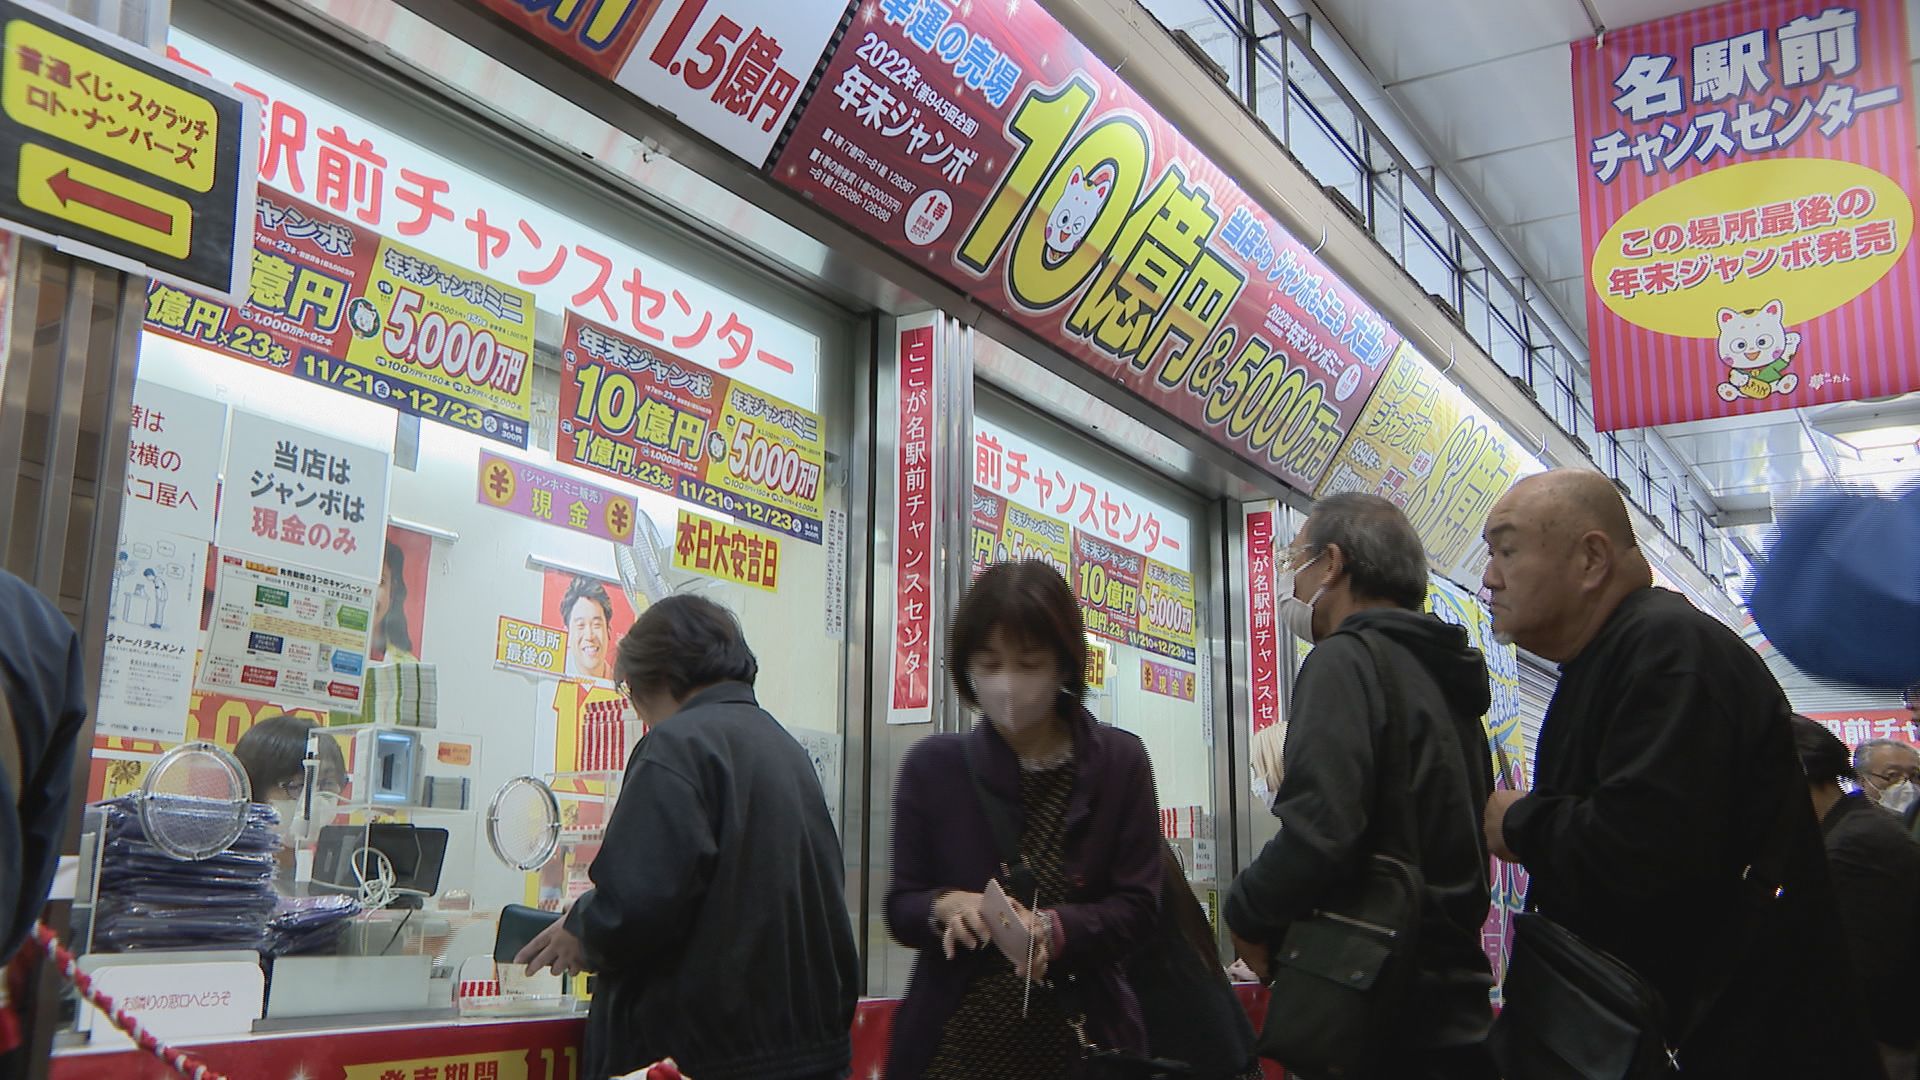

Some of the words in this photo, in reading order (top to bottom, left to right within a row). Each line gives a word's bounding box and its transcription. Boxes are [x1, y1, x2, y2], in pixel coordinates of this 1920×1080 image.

[16, 44, 209, 141] 普通くじ・スクラッチ
[650, 0, 800, 133] 1.5億円
[855, 32, 980, 139] 2022年(第945回全国)
[880, 0, 1022, 107] 幸運の売場
[1613, 8, 1858, 121] 名駅前
[26, 85, 199, 170] ロト・ナンバーズ
[832, 65, 978, 185] 年末ジャンボ
[1591, 85, 1899, 183] チャンスセンター
[954, 73, 1247, 387] 10億円
[1608, 219, 1897, 298] 年末ジャンボ発売
[1620, 185, 1875, 259] この場所最後の
[384, 248, 524, 324] 年末ジャンボミニ
[383, 286, 528, 396] 5,000万円
[579, 327, 713, 399] 年末ジャンボ
[575, 362, 709, 460] 10億円
[731, 388, 818, 442] 年末ジャンボミニ
[1378, 352, 1441, 421] ドリーム
[250, 469, 365, 524] ジャンボは
[274, 440, 351, 486] 当店は
[728, 418, 820, 502] 5,000万円
[975, 431, 1180, 554] 前チャンスセンター
[251, 505, 359, 556] 現金のみ
[676, 511, 779, 589] 本日大安吉日
[903, 341, 928, 699] ここが名駅前チャンスセンター
[1079, 560, 1139, 618] 10億円
[1253, 520, 1273, 733] ここが名駅前チャンスセ
[505, 622, 561, 651] この場所
[506, 641, 553, 668] 最後の
